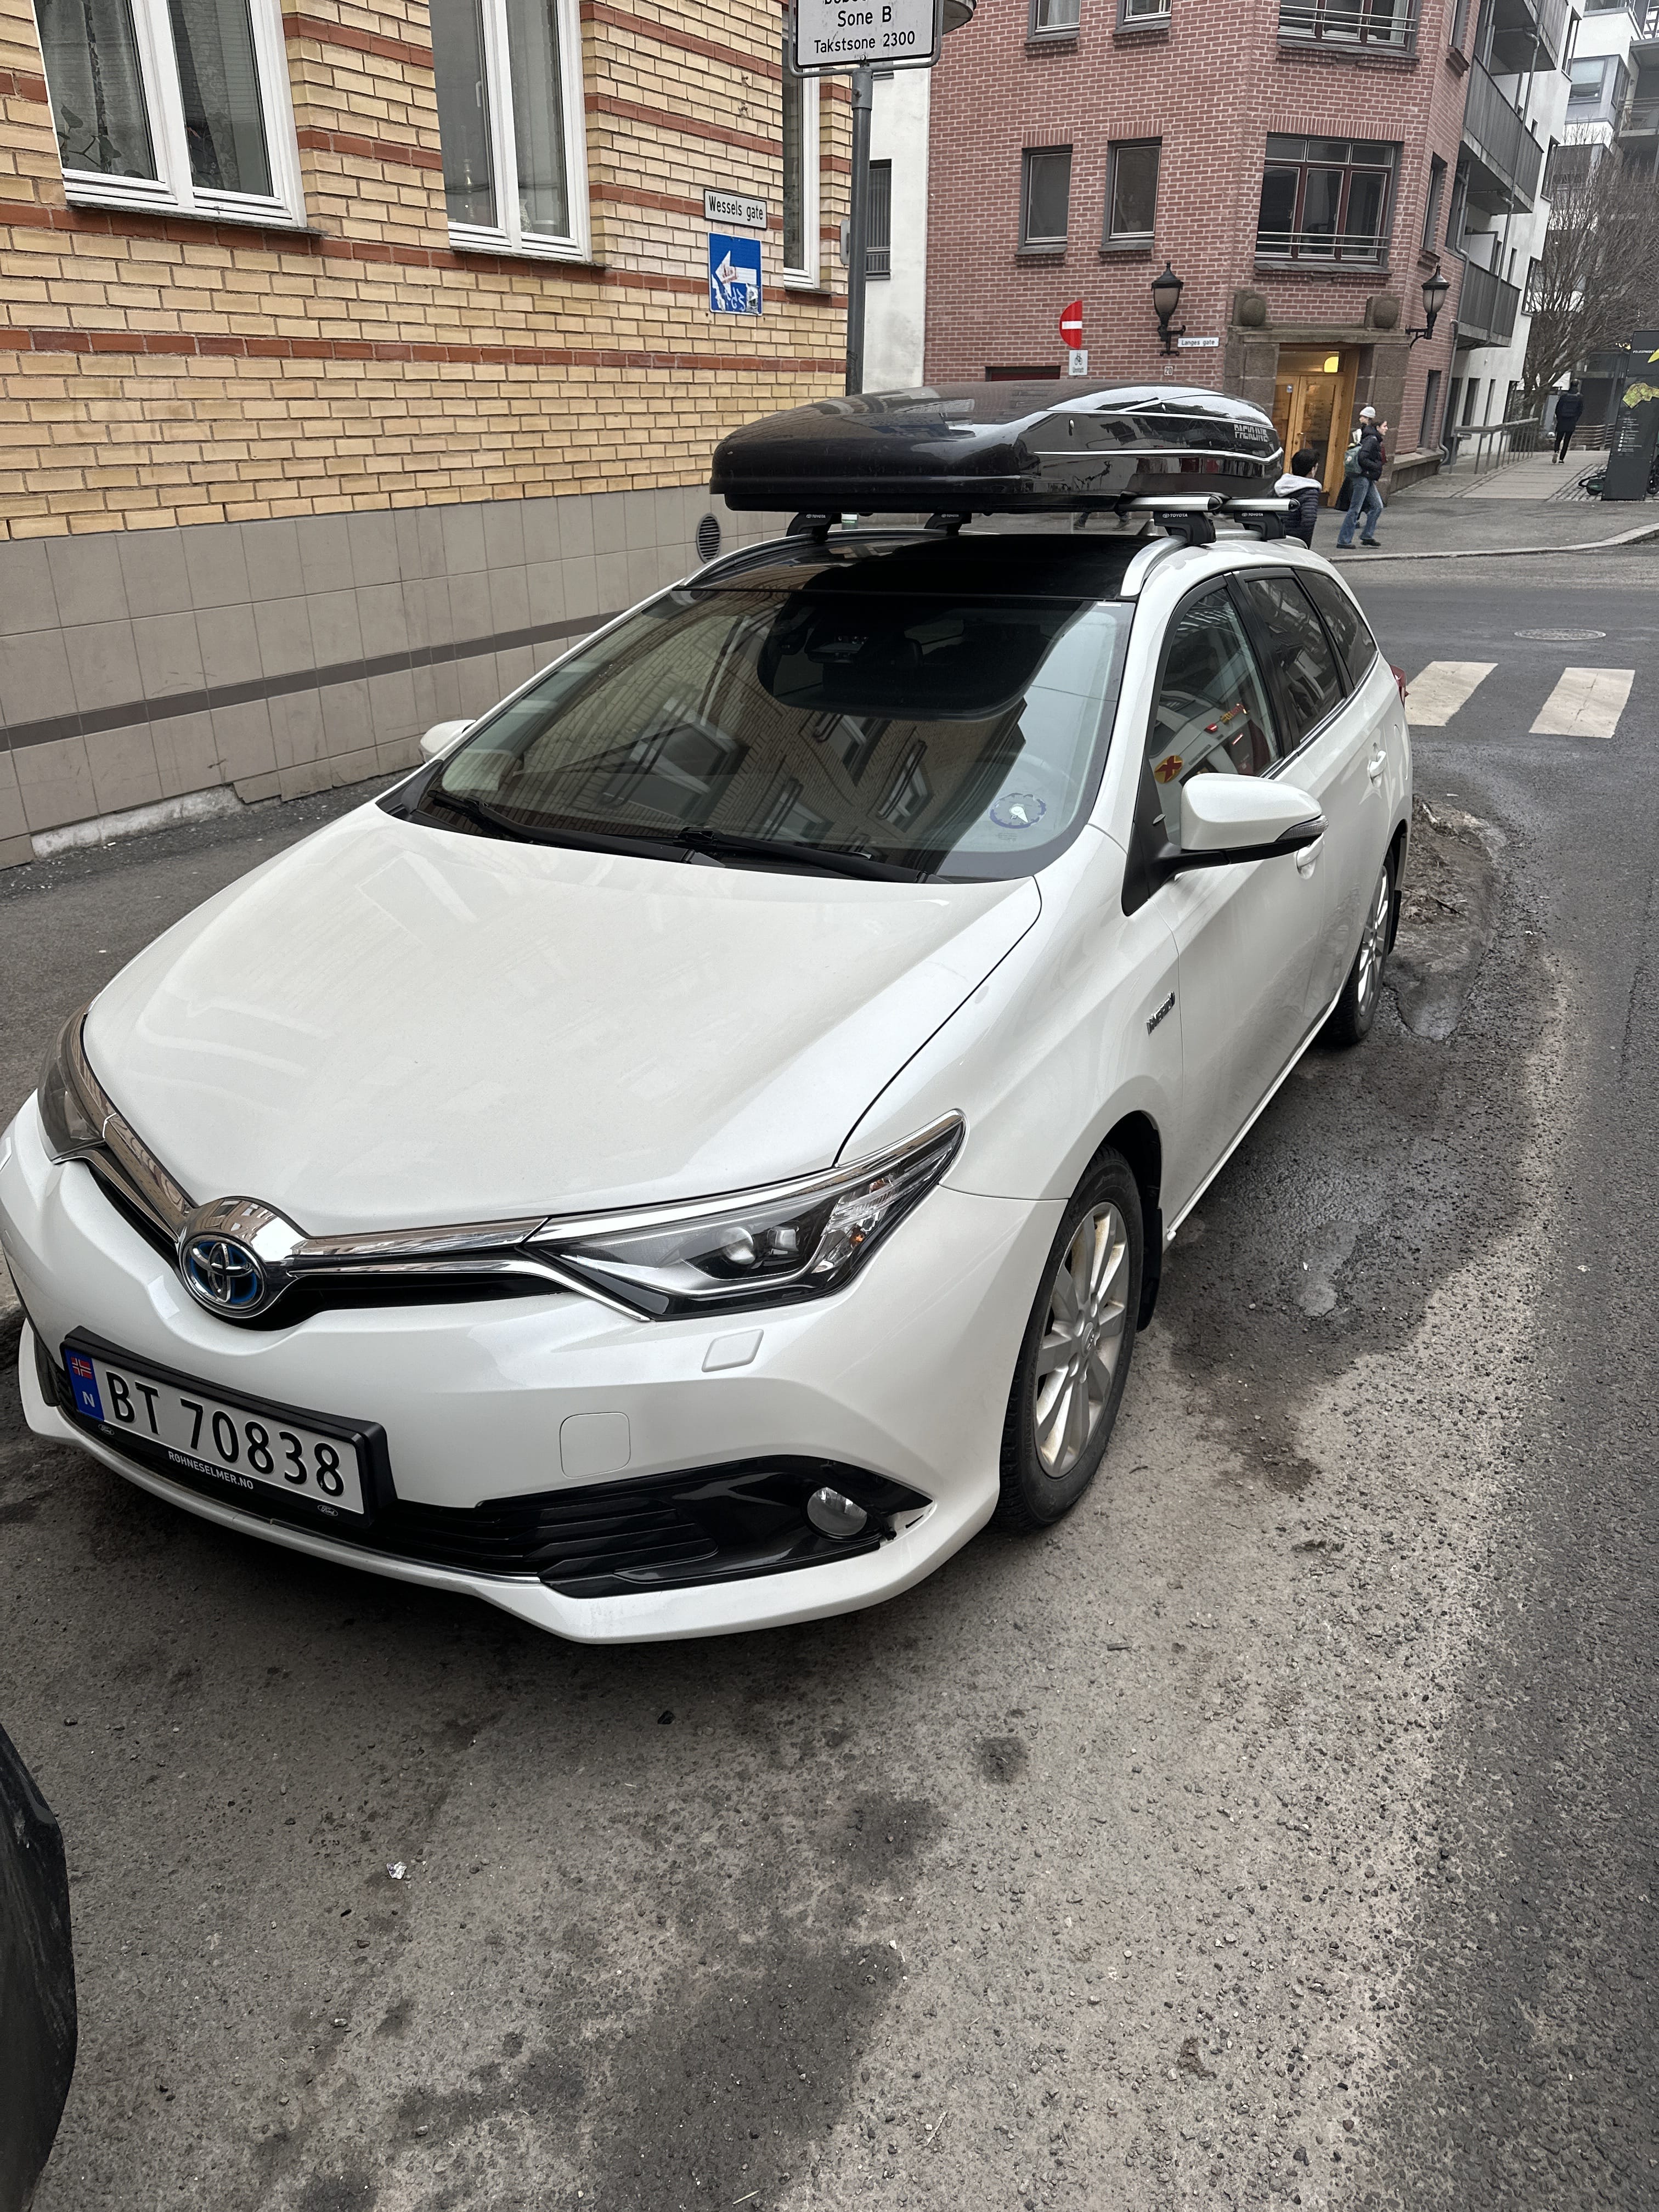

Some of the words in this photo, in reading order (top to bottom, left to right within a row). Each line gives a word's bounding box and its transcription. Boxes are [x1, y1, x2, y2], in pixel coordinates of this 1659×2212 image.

[837, 10, 873, 27] Sone
[882, 5, 892, 23] B
[814, 38, 876, 53] Takstsone
[883, 31, 915, 47] 2300
[709, 195, 742, 216] Wessels
[747, 205, 763, 221] gate
[1234, 424, 1269, 443] PACKLINE
[82, 1391, 95, 1408] N
[106, 1370, 160, 1435] BT
[180, 1398, 345, 1497] 70838
